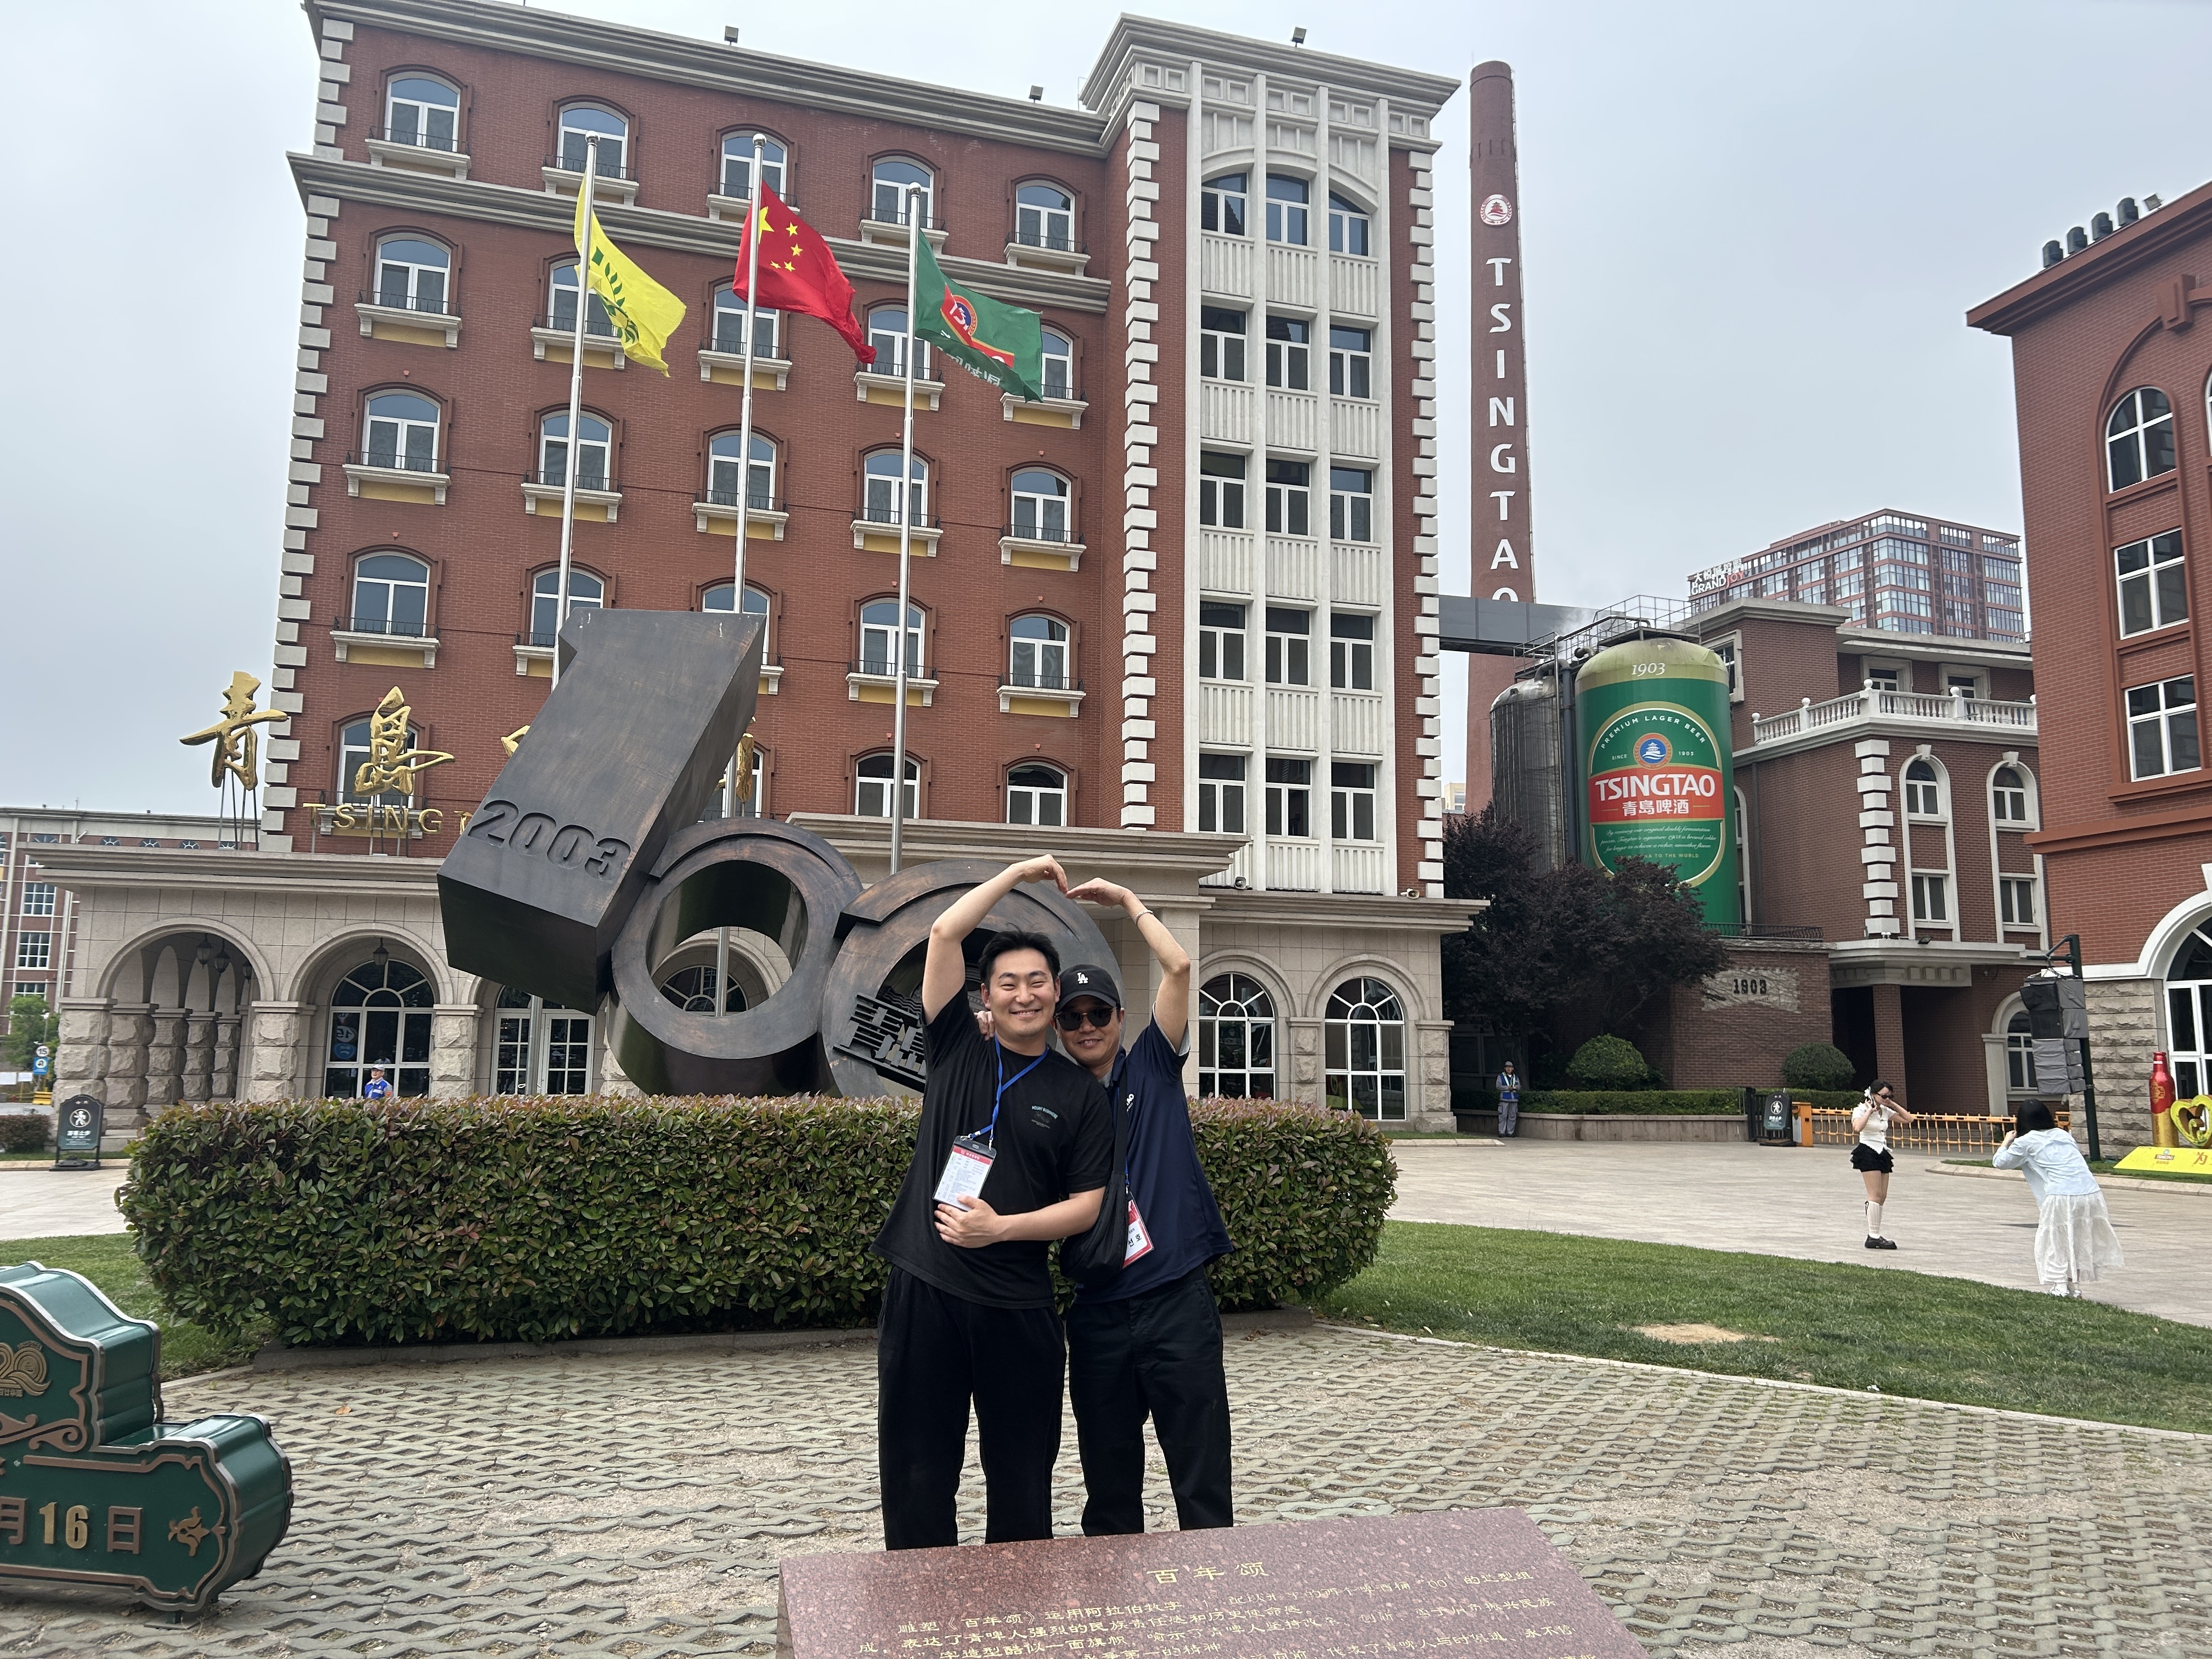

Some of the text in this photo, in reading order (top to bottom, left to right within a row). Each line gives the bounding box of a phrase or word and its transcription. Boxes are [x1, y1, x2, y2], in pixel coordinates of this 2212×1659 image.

[1631, 662, 1666, 677] 1903
[1600, 715, 1706, 749] PREMIUM LAGER BEER
[1595, 774, 1715, 802] TSINGTAO
[467, 799, 631, 880] 2003
[1077, 972, 1088, 984] LA
[1733, 979, 1767, 995] 1903
[2193, 1152, 2208, 1165] 为
[1147, 1561, 1269, 1584] 百年颂
